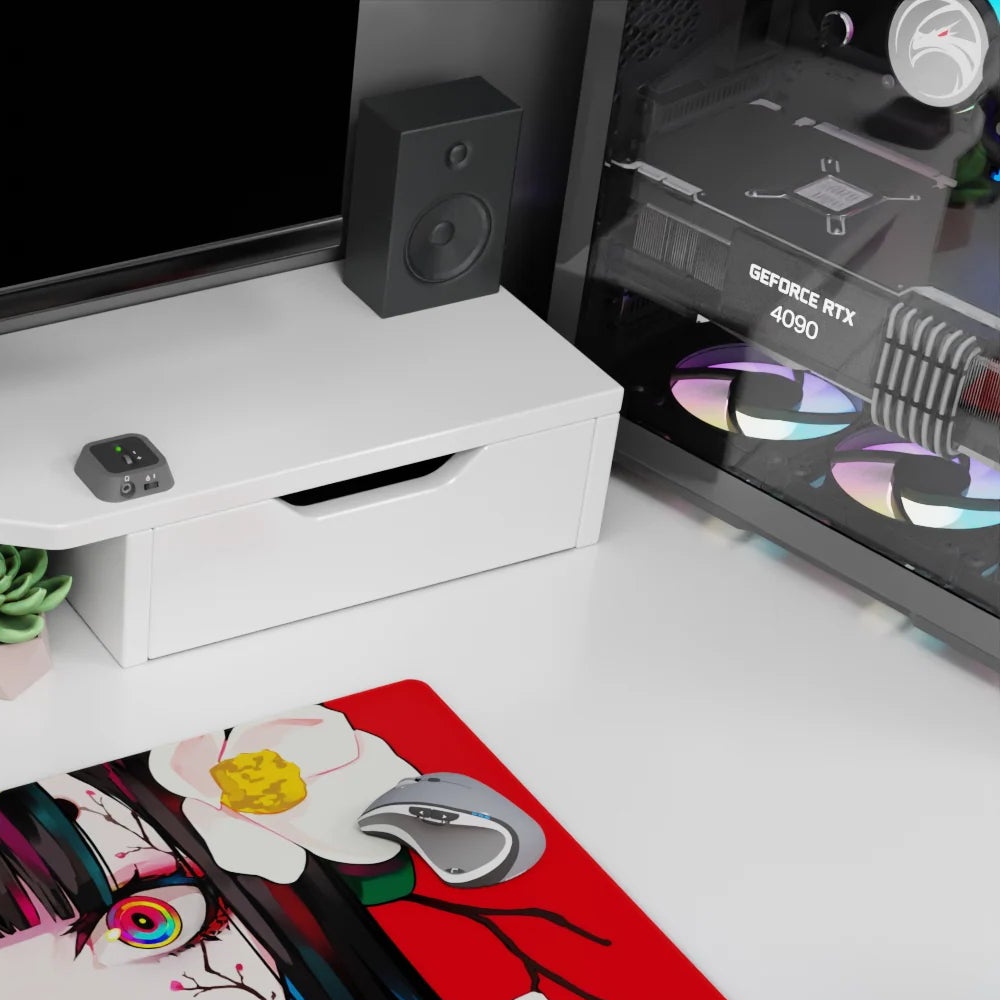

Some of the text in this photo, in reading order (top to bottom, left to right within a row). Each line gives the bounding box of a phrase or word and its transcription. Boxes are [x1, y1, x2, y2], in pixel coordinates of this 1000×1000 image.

[749, 263, 856, 327] GEFORCE RTX
[769, 305, 819, 340] 4090
